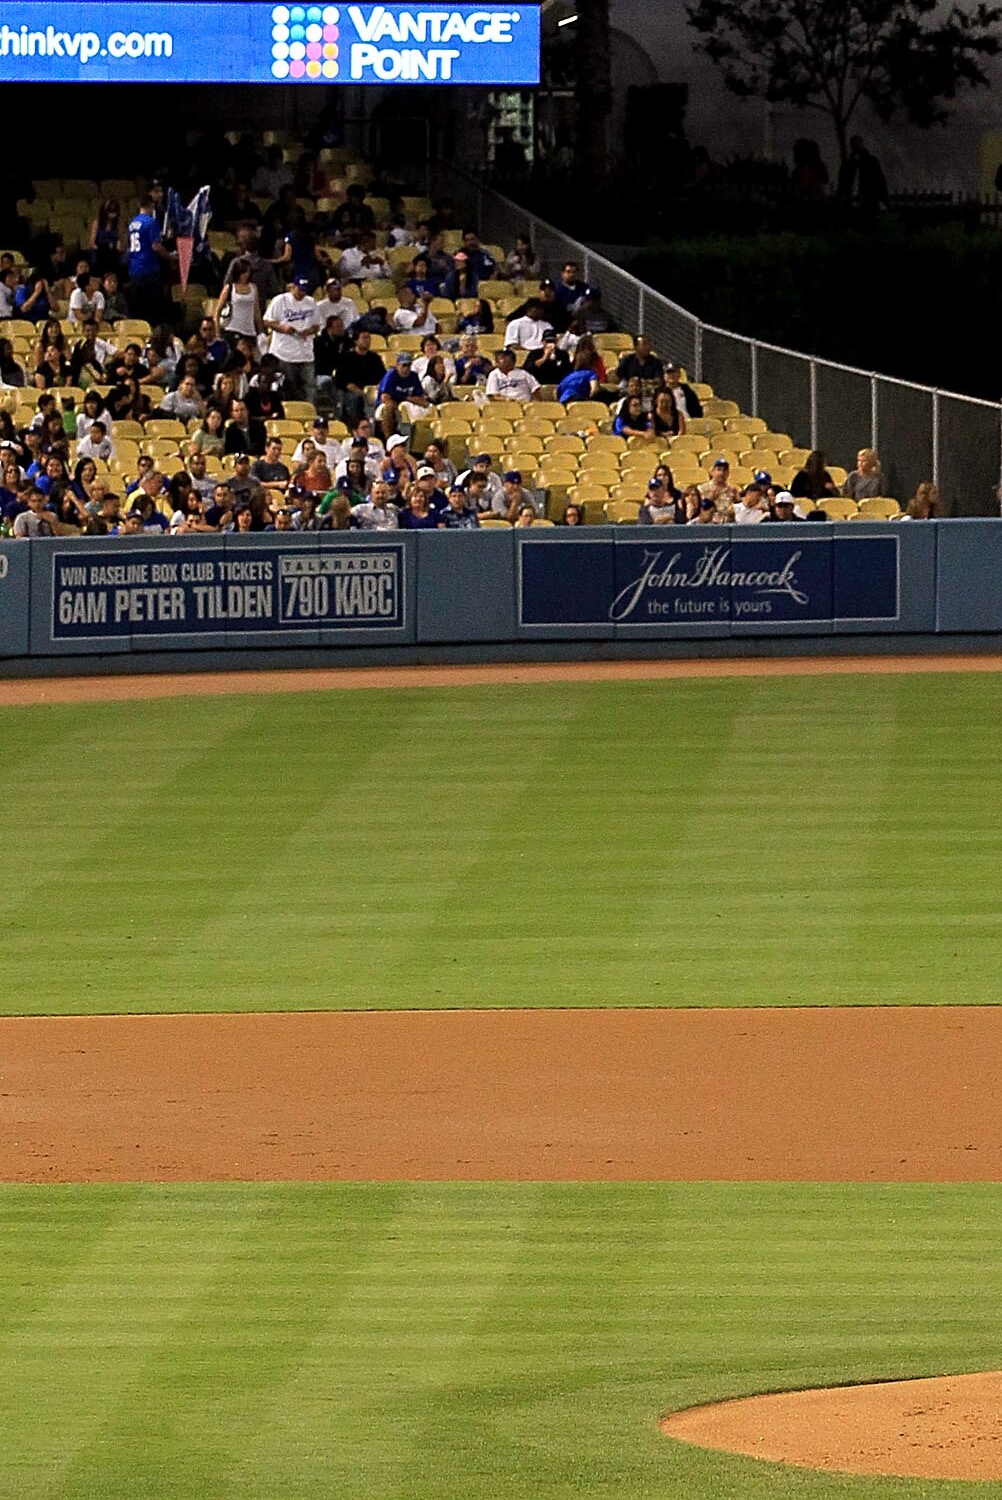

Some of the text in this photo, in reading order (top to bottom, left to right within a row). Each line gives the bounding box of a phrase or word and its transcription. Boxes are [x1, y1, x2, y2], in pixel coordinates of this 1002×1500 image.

[347, 6, 514, 43] VANTAGE
[0, 25, 173, 64] hinkvp.com
[350, 43, 461, 80] POINT
[61, 561, 273, 587] WIN BASELINE BOX CLUB TICKETS
[608, 546, 809, 620] John Hancock
[59, 585, 273, 624] 6AM PETER TILDEN
[284, 574, 393, 617] 790 KABC
[648, 597, 772, 616] the future is yours
